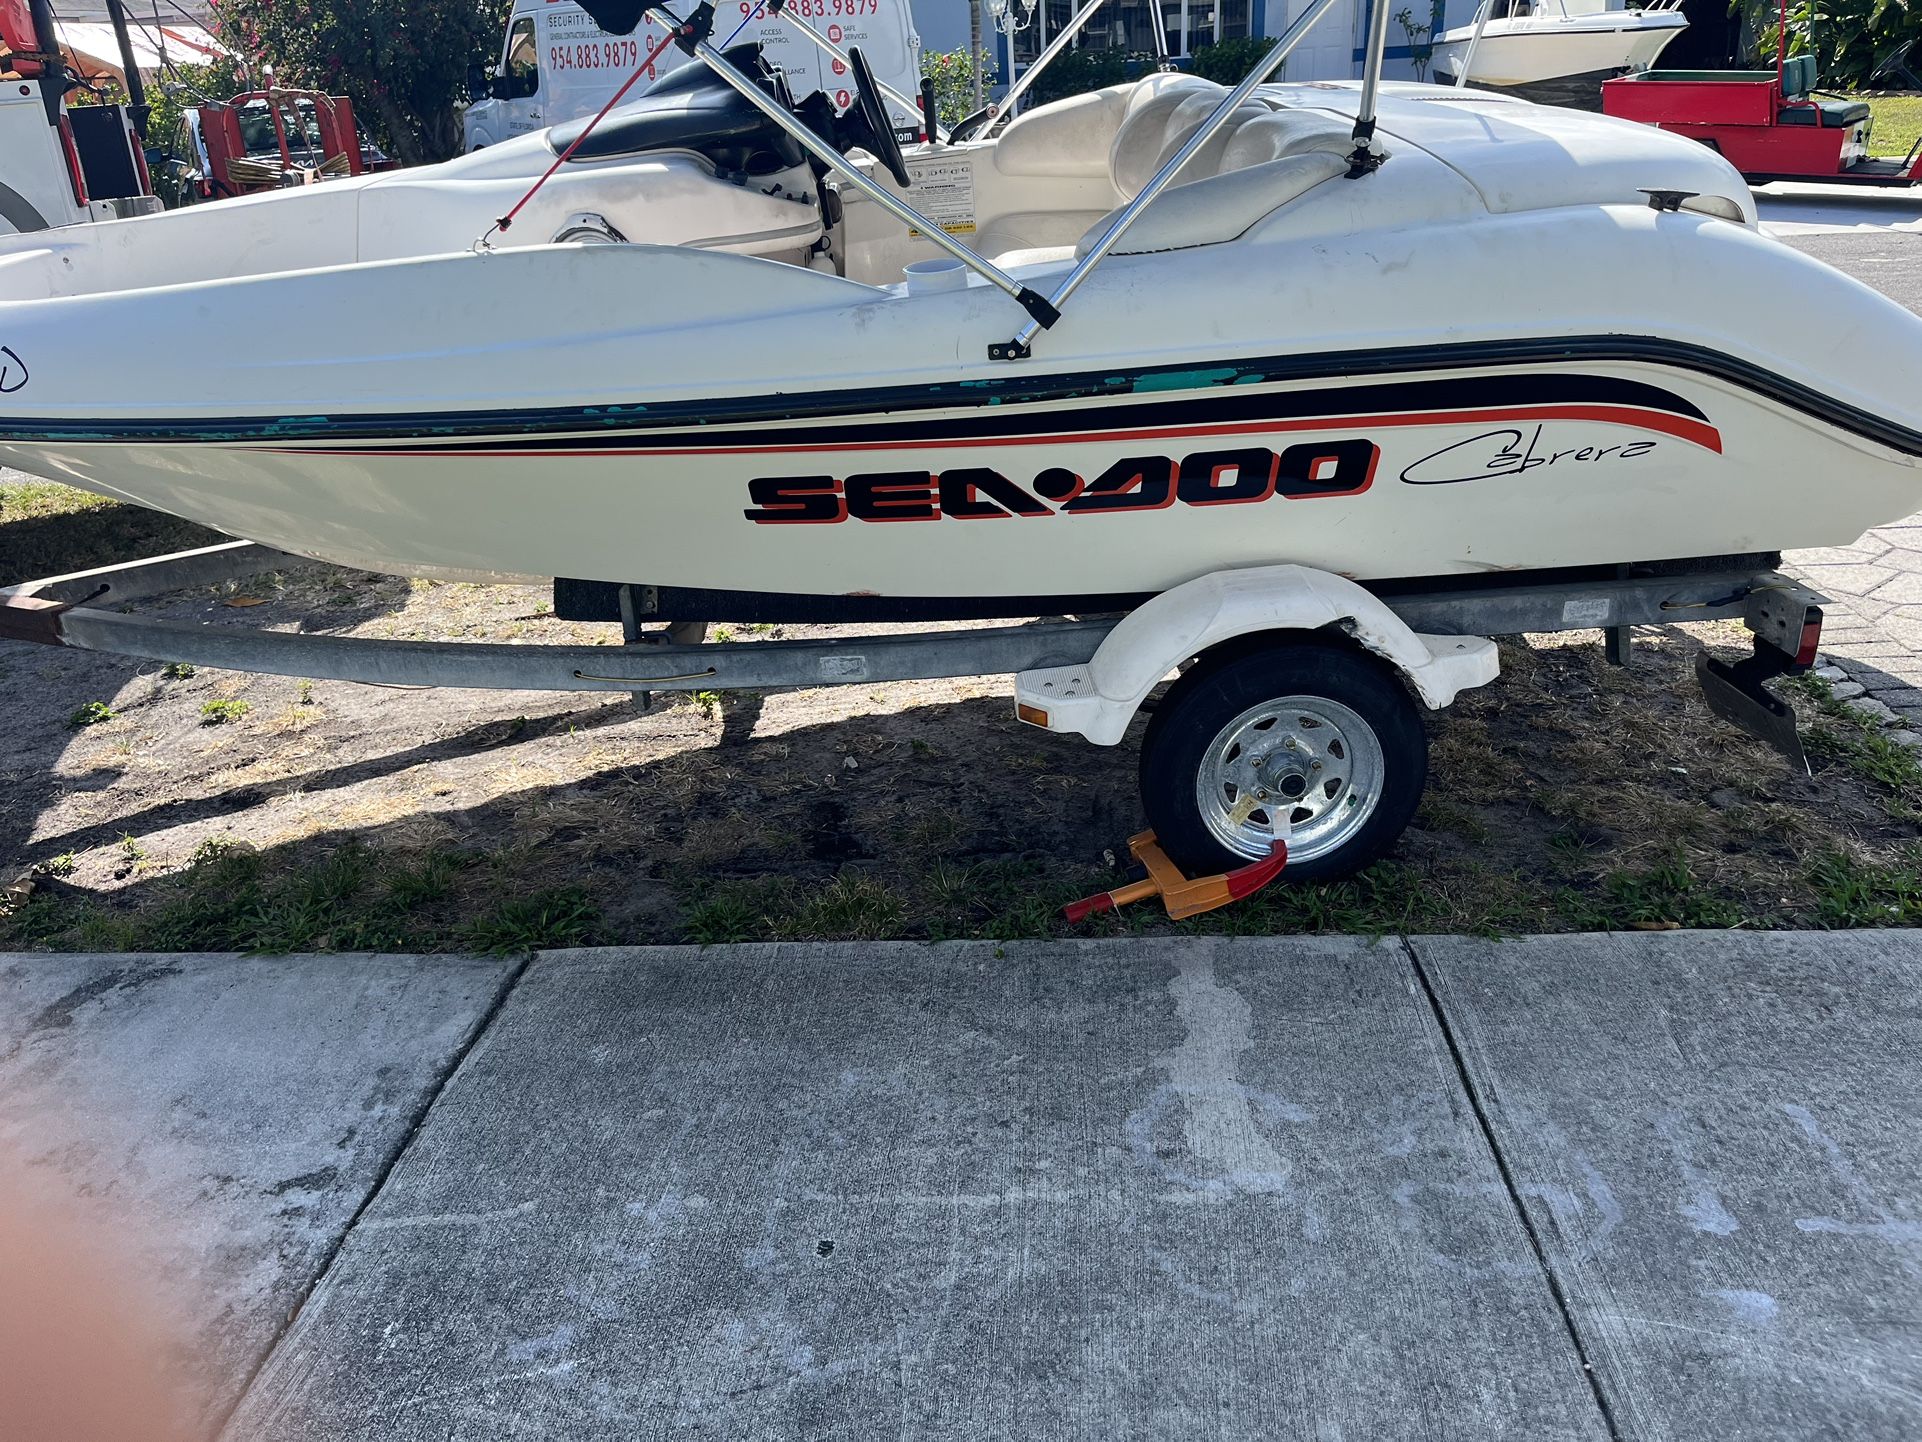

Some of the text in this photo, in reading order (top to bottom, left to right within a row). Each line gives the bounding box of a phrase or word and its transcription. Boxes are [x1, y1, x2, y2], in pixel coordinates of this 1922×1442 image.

[548, 14, 586, 28] SECURITY
[551, 41, 637, 70] 954.883.9879
[1400, 424, 1657, 485] Cabrera
